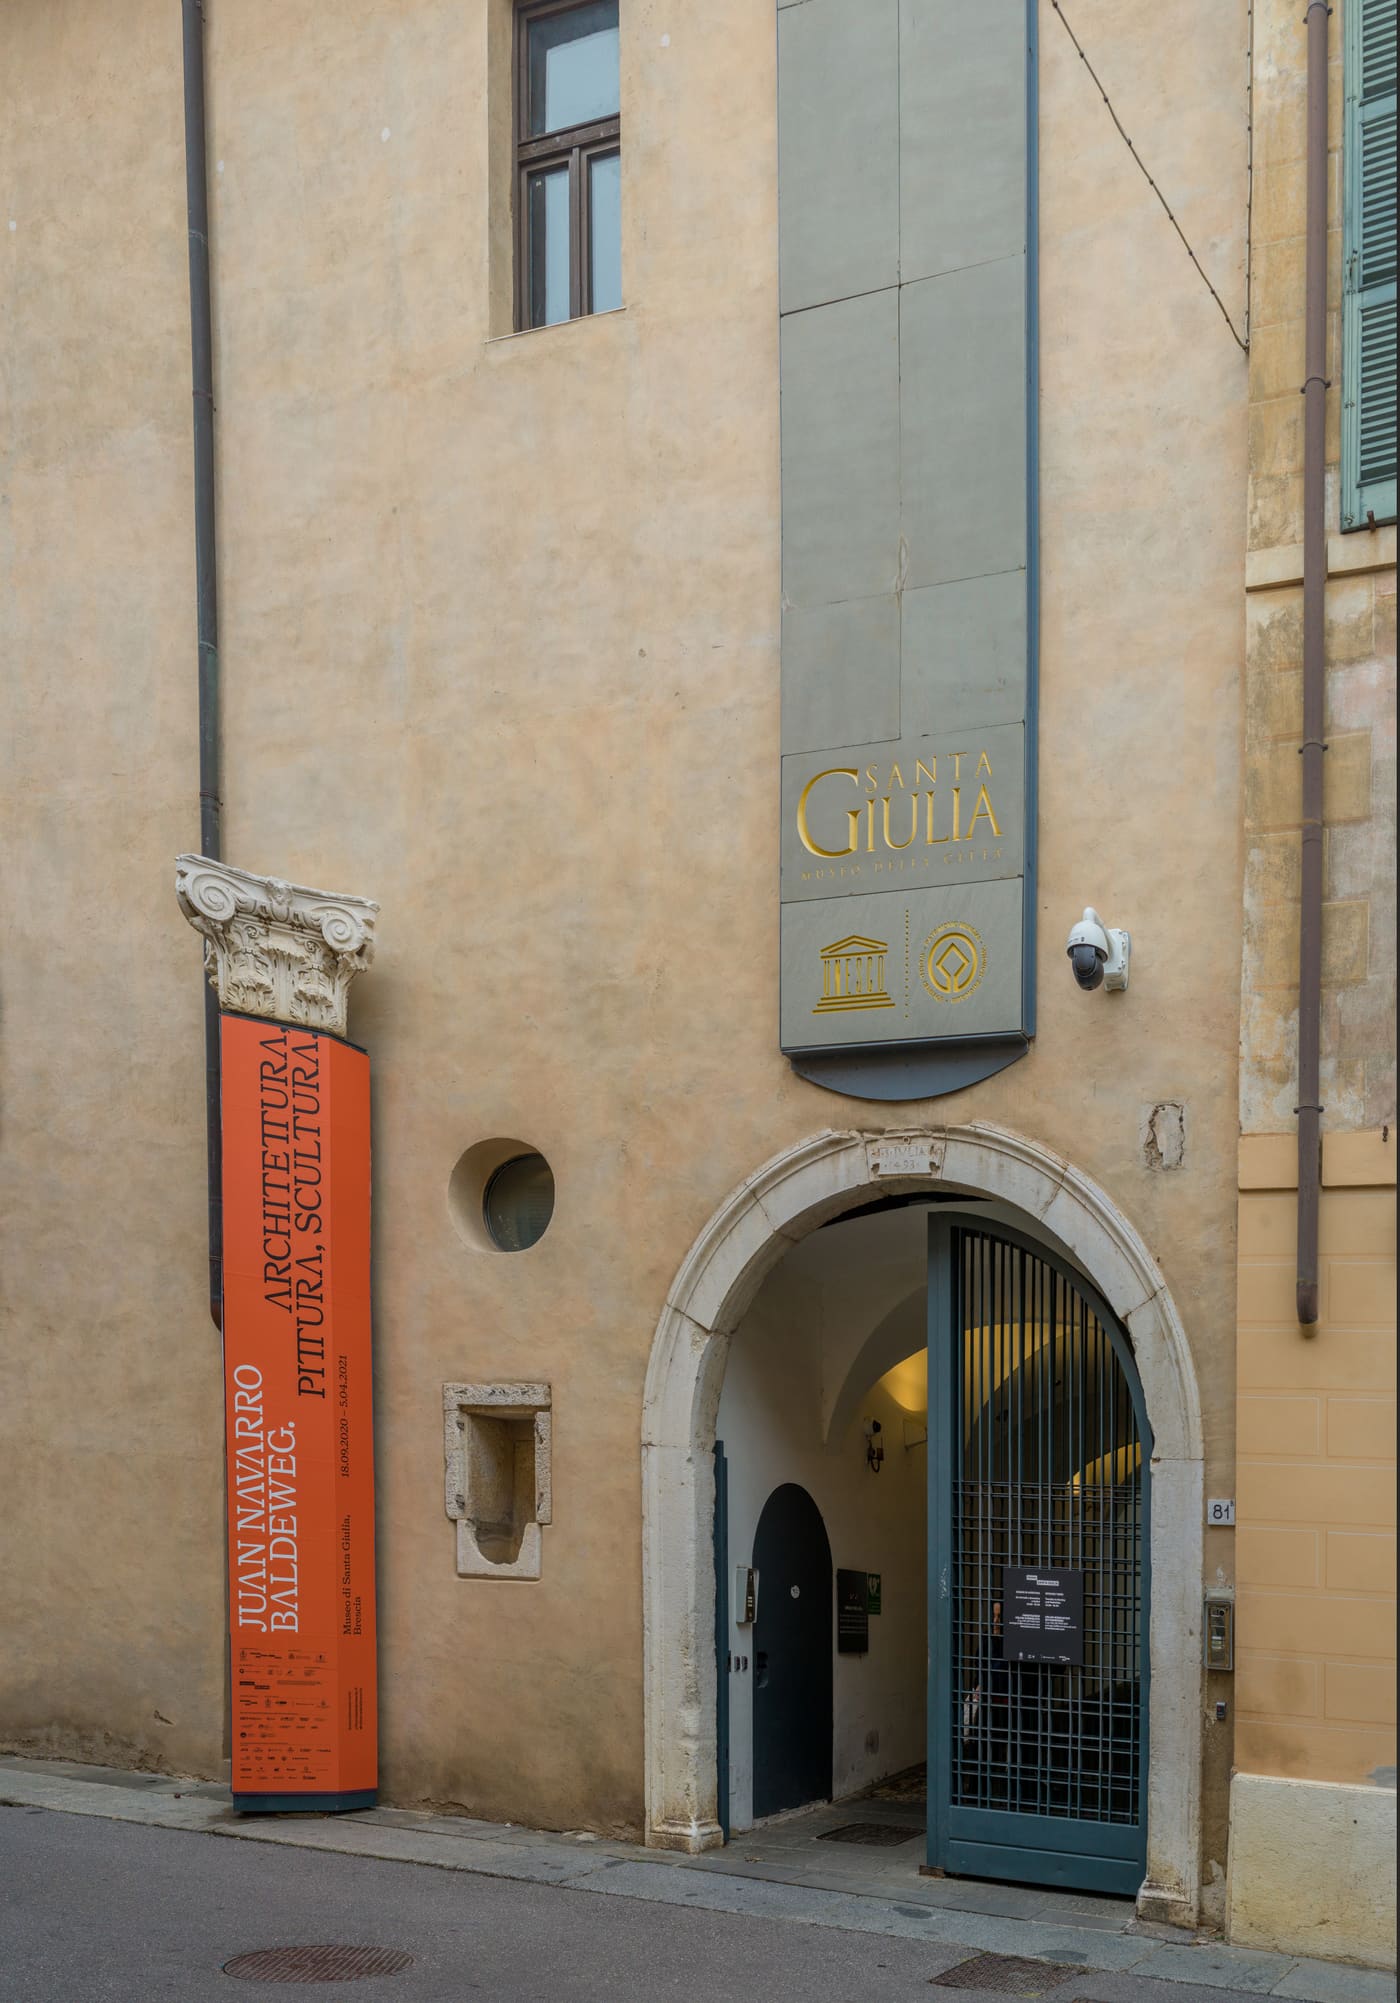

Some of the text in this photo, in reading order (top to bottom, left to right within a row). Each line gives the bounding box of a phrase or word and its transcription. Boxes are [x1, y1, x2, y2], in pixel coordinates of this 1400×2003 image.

[864, 750, 994, 793] SANTA
[796, 766, 1005, 859] GIULIA
[800, 863, 861, 882] MUSEO
[823, 955, 885, 996] UNESCO
[295, 1243, 326, 1399] PITTURA,
[338, 1354, 349, 1408] 5.04.2021
[233, 1364, 265, 1533] NAVARRO
[340, 1418, 350, 1478] 18.09.2020
[267, 1420, 298, 1633] BALDEWEG.
[237, 1539, 267, 1633] JUAN
[341, 1514, 352, 1636] Museo di Santa Giulia,
[352, 1597, 362, 1636] Brescia
